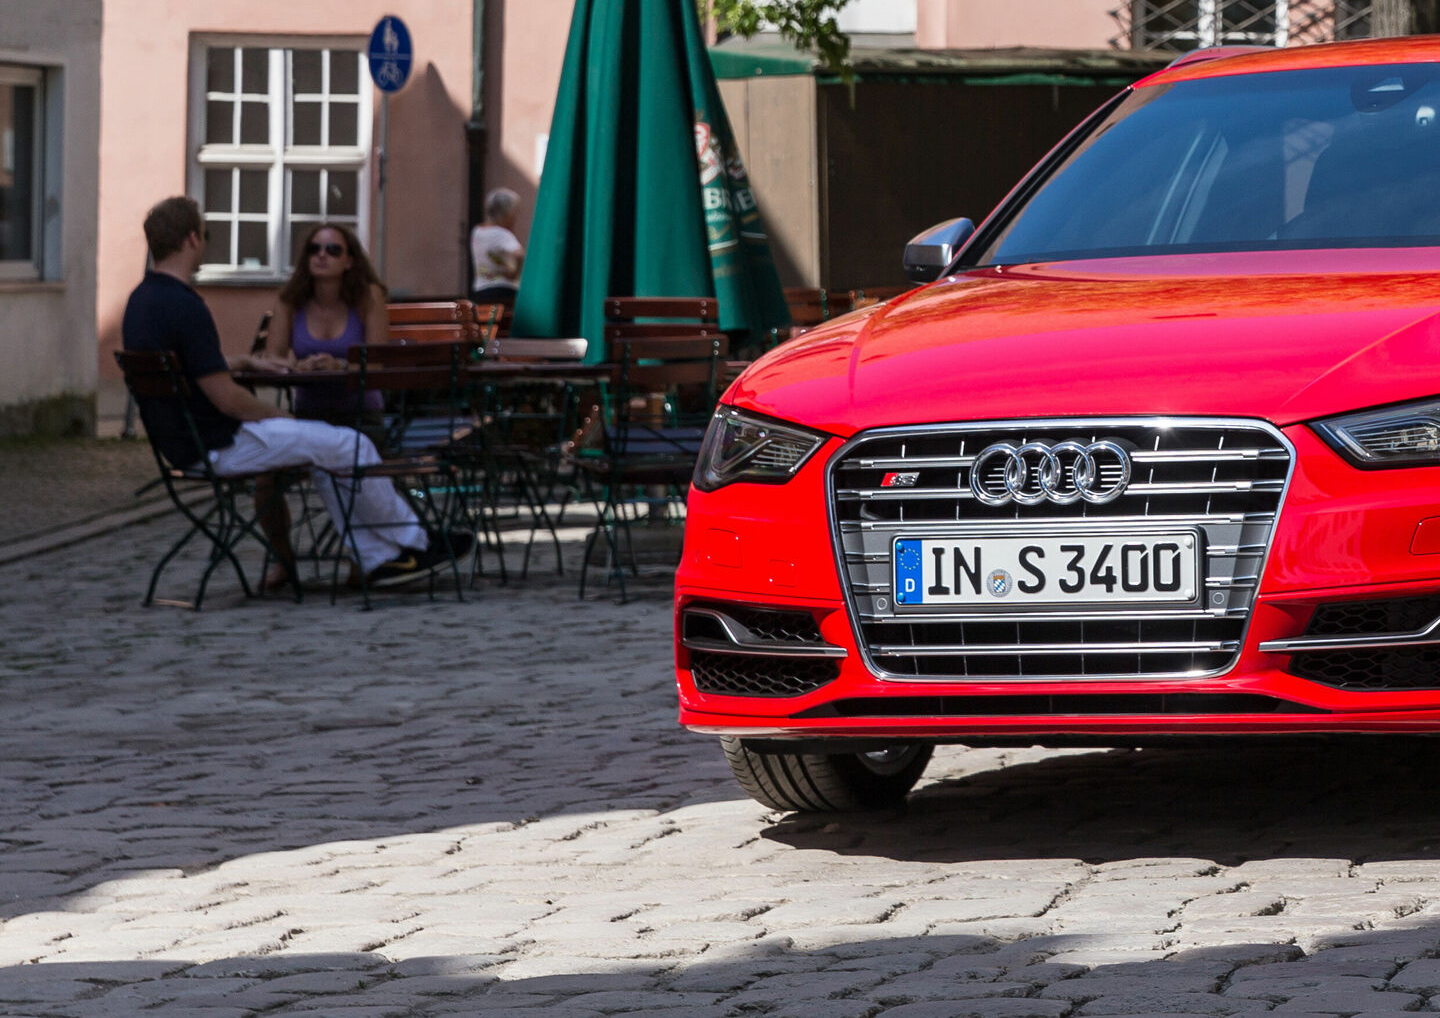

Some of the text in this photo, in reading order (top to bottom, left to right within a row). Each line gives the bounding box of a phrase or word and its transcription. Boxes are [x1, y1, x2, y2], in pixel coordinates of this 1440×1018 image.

[905, 578, 916, 593] D
[928, 543, 1181, 595] IN S 3400
